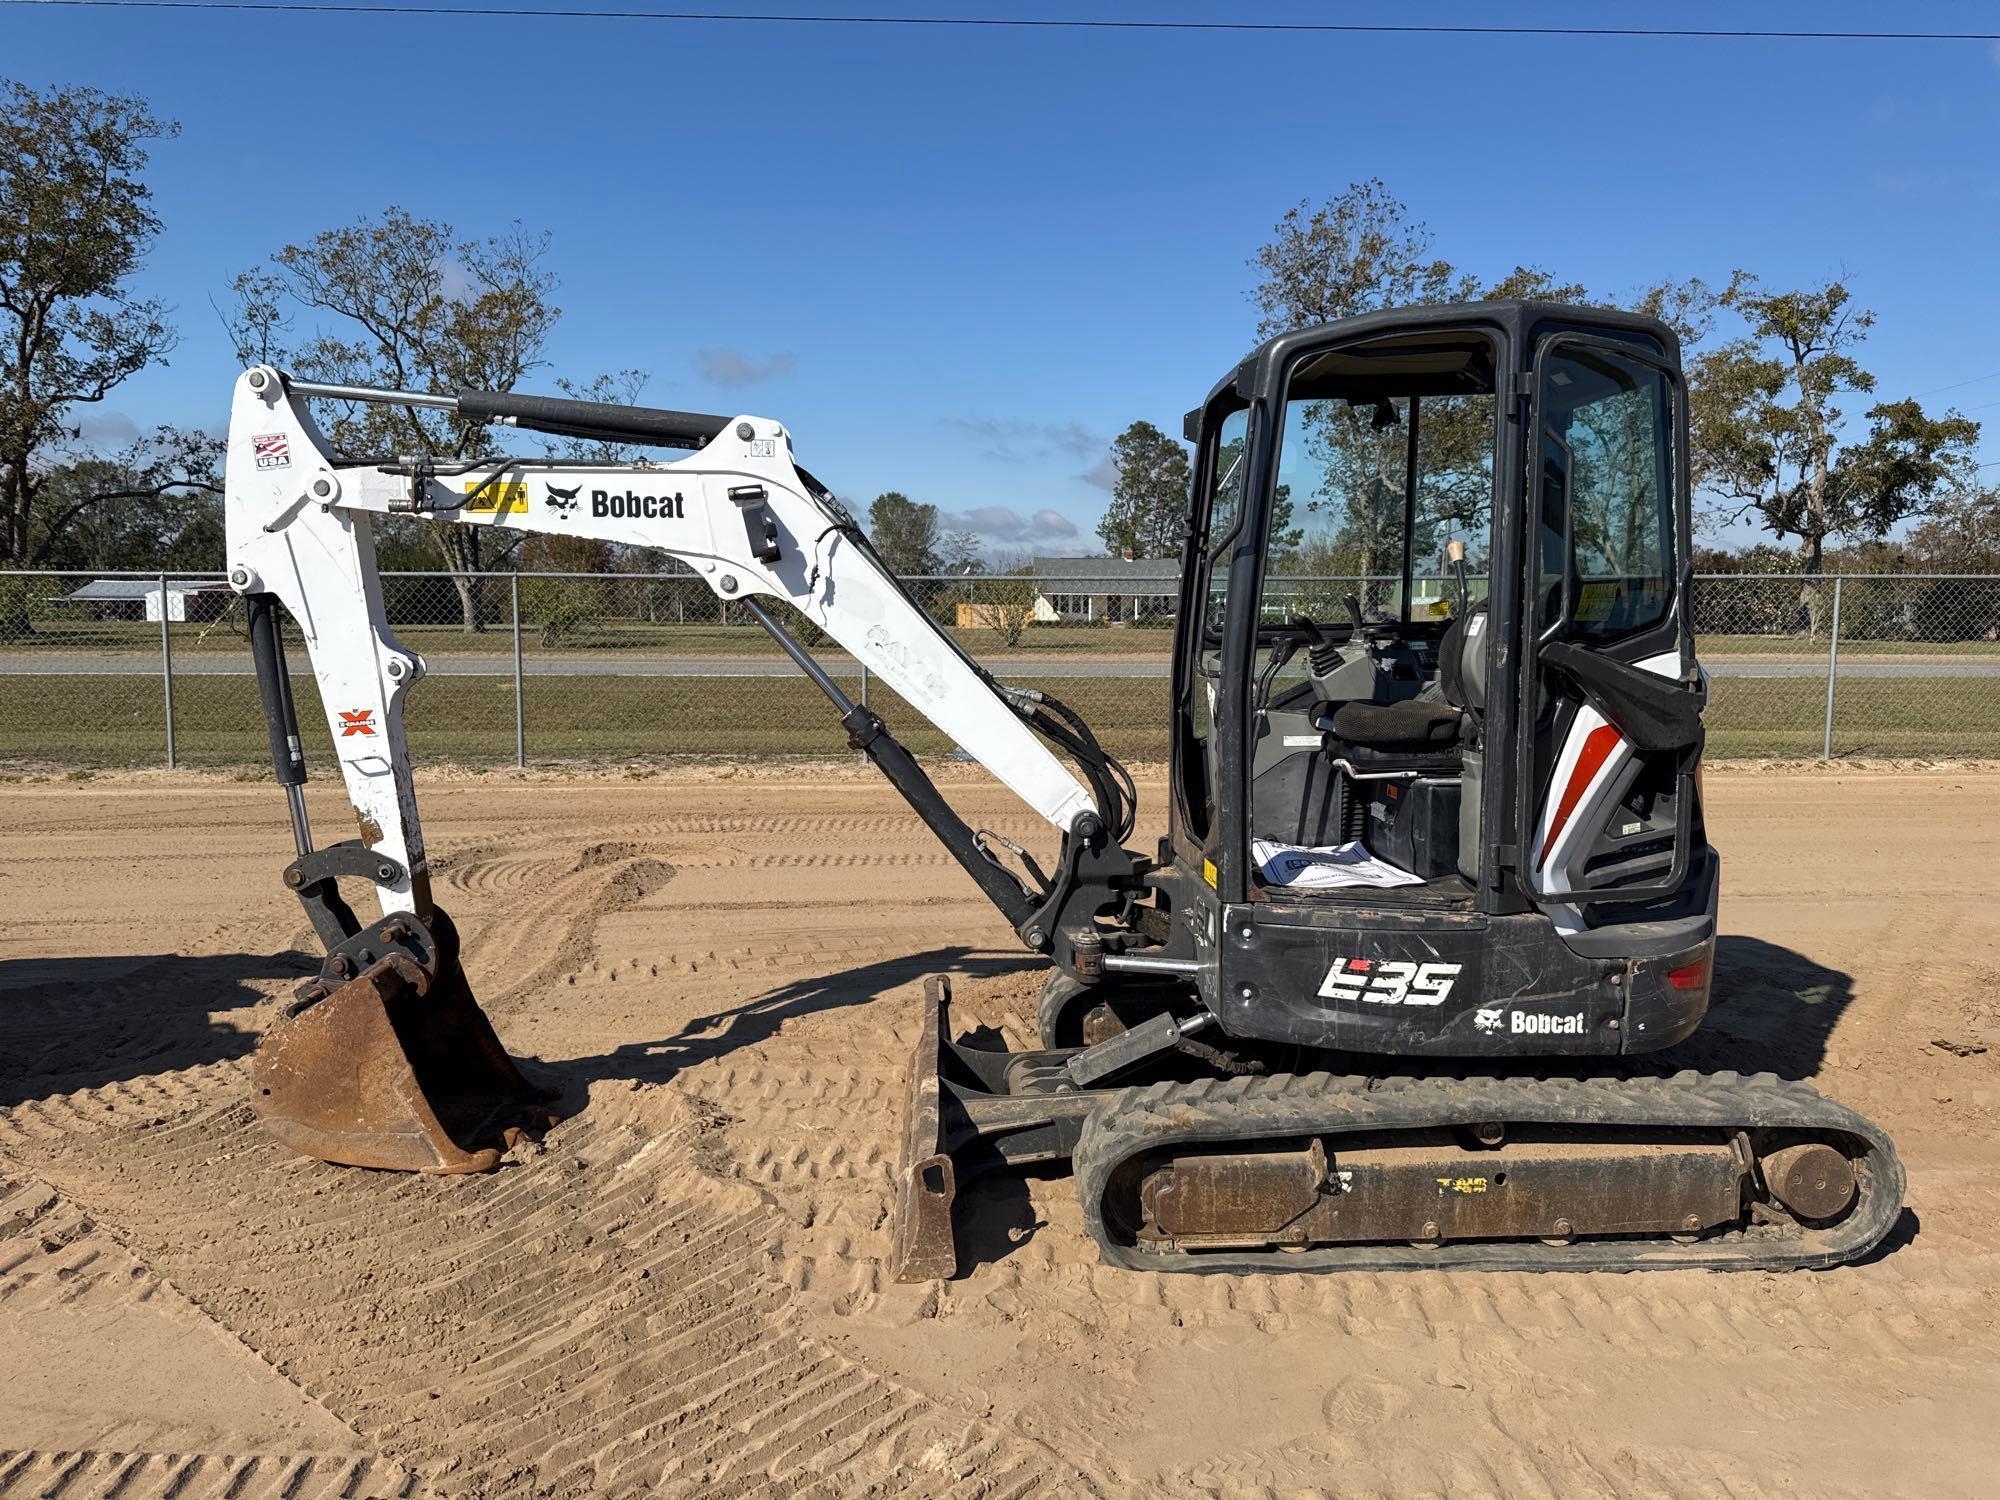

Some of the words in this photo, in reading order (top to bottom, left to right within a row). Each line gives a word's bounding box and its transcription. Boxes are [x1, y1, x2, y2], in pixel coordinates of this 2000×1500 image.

[258, 457, 288, 467] USA
[592, 490, 684, 518] Bobcat
[1317, 957, 1463, 1006] E35
[1511, 1010, 1584, 1034] Bobcat
